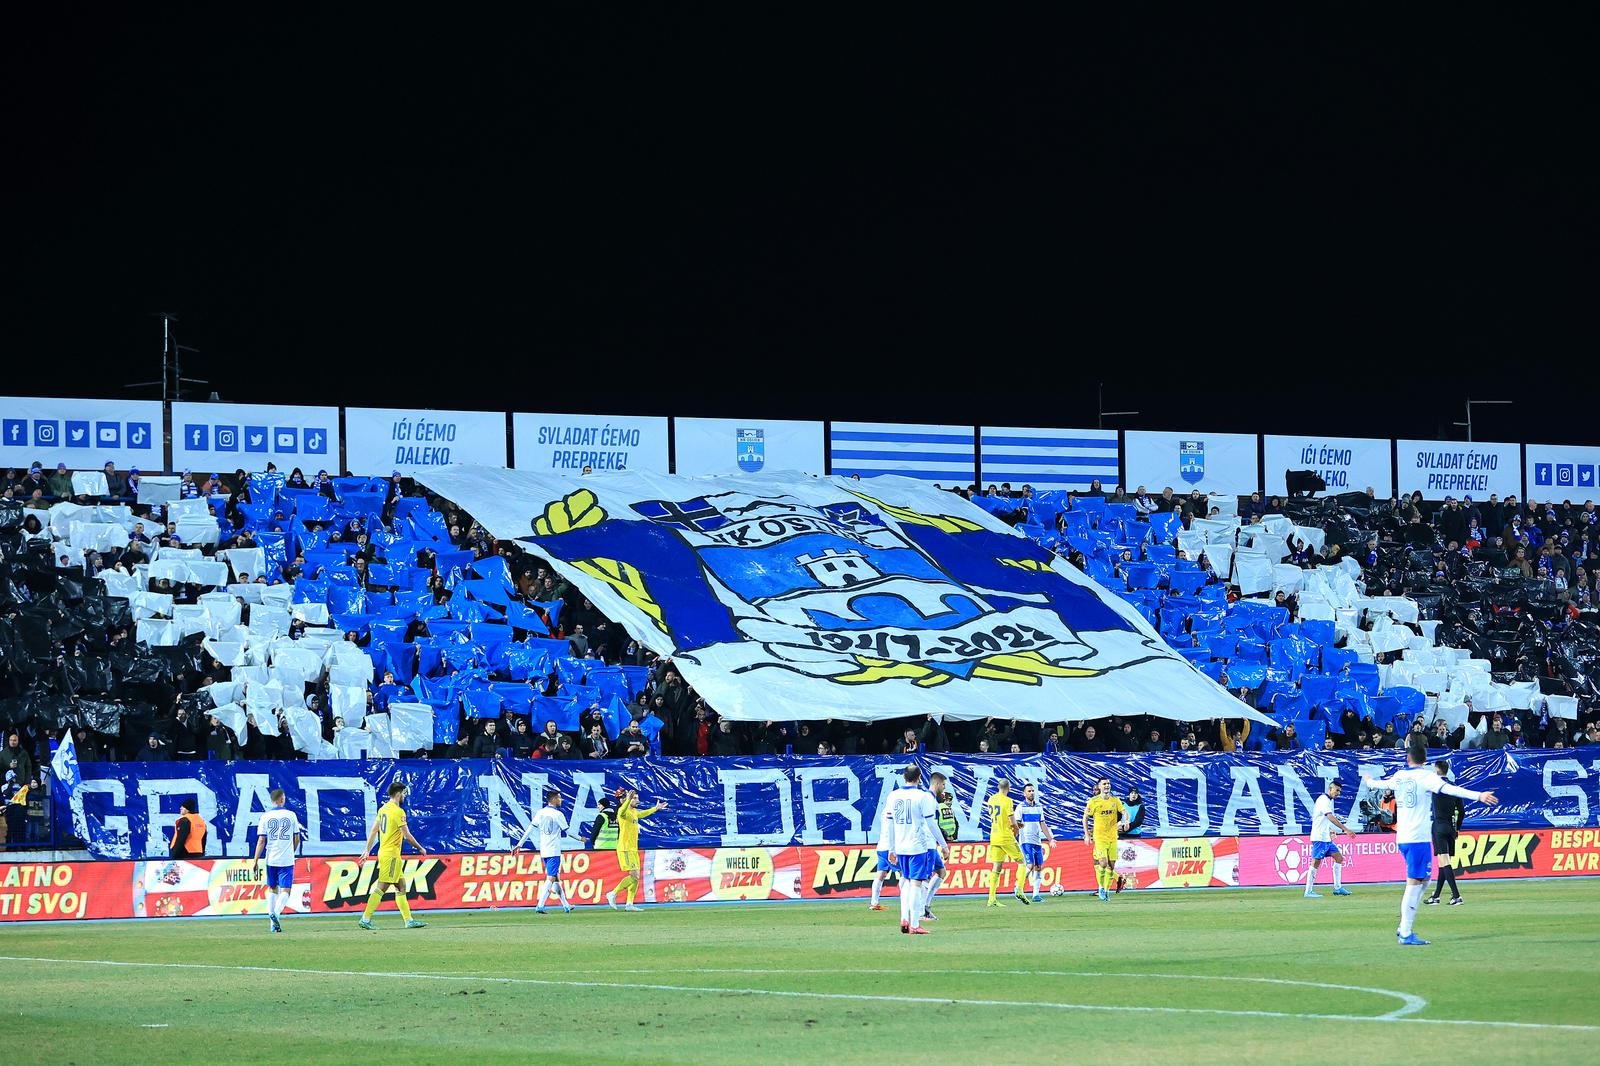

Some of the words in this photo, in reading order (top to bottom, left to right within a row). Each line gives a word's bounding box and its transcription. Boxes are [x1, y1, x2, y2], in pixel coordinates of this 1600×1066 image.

[392, 418, 411, 440] IĆI
[415, 418, 456, 441] ĆEMO
[538, 426, 598, 446] SVLADAT
[600, 424, 640, 447] ĆEMO
[1301, 444, 1317, 464] IĆI
[1319, 444, 1352, 466] ĆEMO
[1416, 452, 1465, 469] SVLADAT
[1466, 450, 1498, 470] ĆEMO
[1314, 470, 1349, 489] EKO,
[1427, 473, 1488, 491] PREPREKE!
[68, 774, 380, 859] GRAD
[478, 772, 607, 850] NA
[1150, 764, 1456, 838] DANA
[1542, 759, 1600, 828] S
[893, 798, 913, 825] 21
[267, 817, 292, 841] 22
[1171, 846, 1192, 858] WHEEL
[1192, 846, 1201, 858] OF
[1301, 843, 1353, 856] HSKI
[1450, 832, 1536, 870] RIZK
[460, 853, 590, 877] BESPLANO
[726, 857, 750, 870] WHEEL
[751, 856, 760, 869] OF
[1165, 860, 1207, 877] RIZK
[1302, 857, 1328, 868] PA
[1330, 856, 1353, 868] LGA
[1552, 853, 1600, 872] ZAVR
[0, 865, 72, 888] ATNO
[225, 868, 252, 882] WHEEL
[719, 871, 766, 889] RIZK
[218, 884, 269, 903] RIZK
[26, 892, 88, 919] SVOJ
